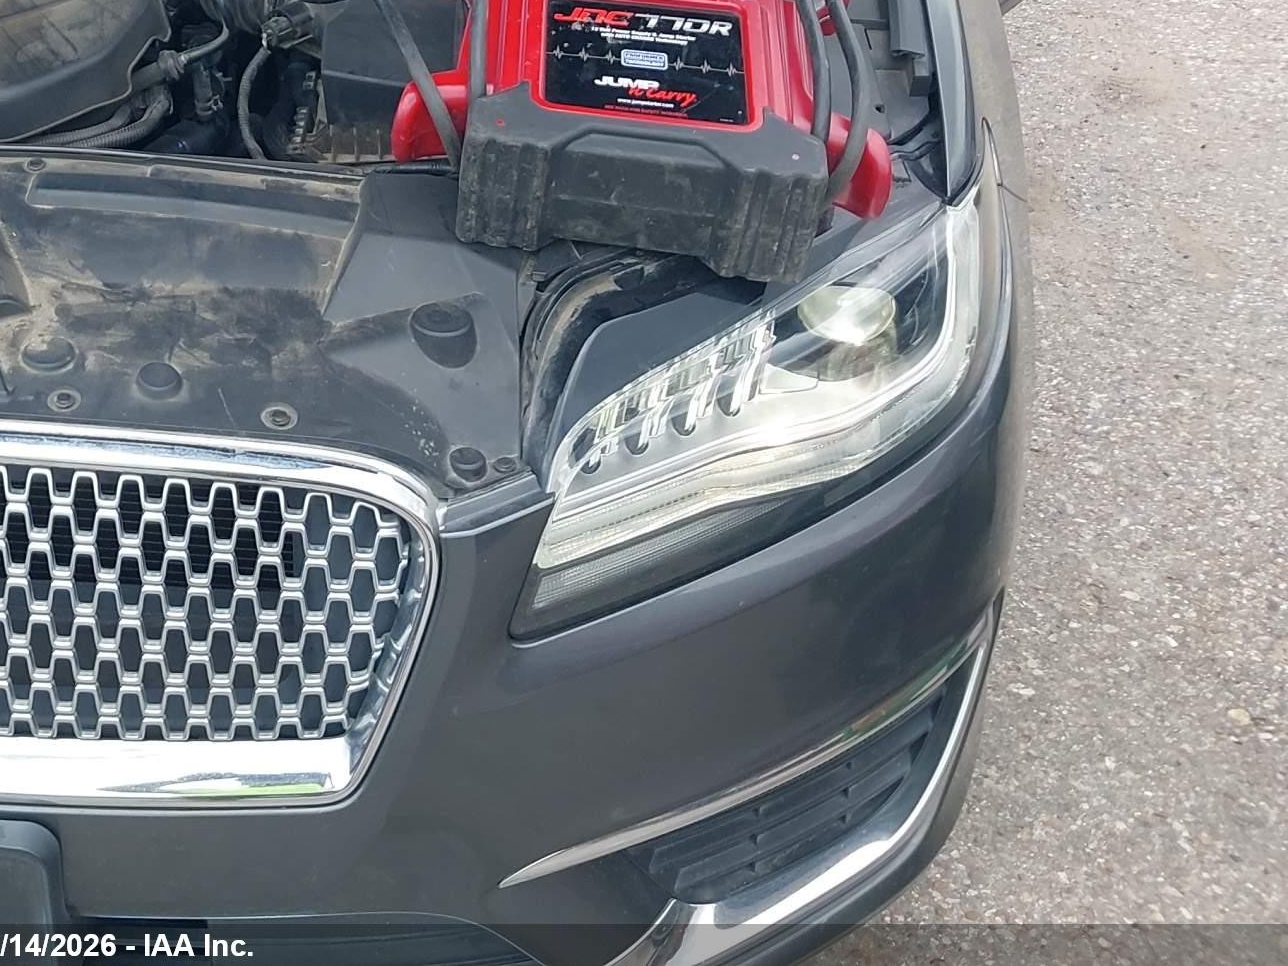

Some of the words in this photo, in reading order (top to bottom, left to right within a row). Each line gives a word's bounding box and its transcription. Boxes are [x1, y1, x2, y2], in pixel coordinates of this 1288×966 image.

[634, 13, 733, 37] 770R
[594, 76, 660, 89] JUMP
[648, 86, 698, 108] Carry
